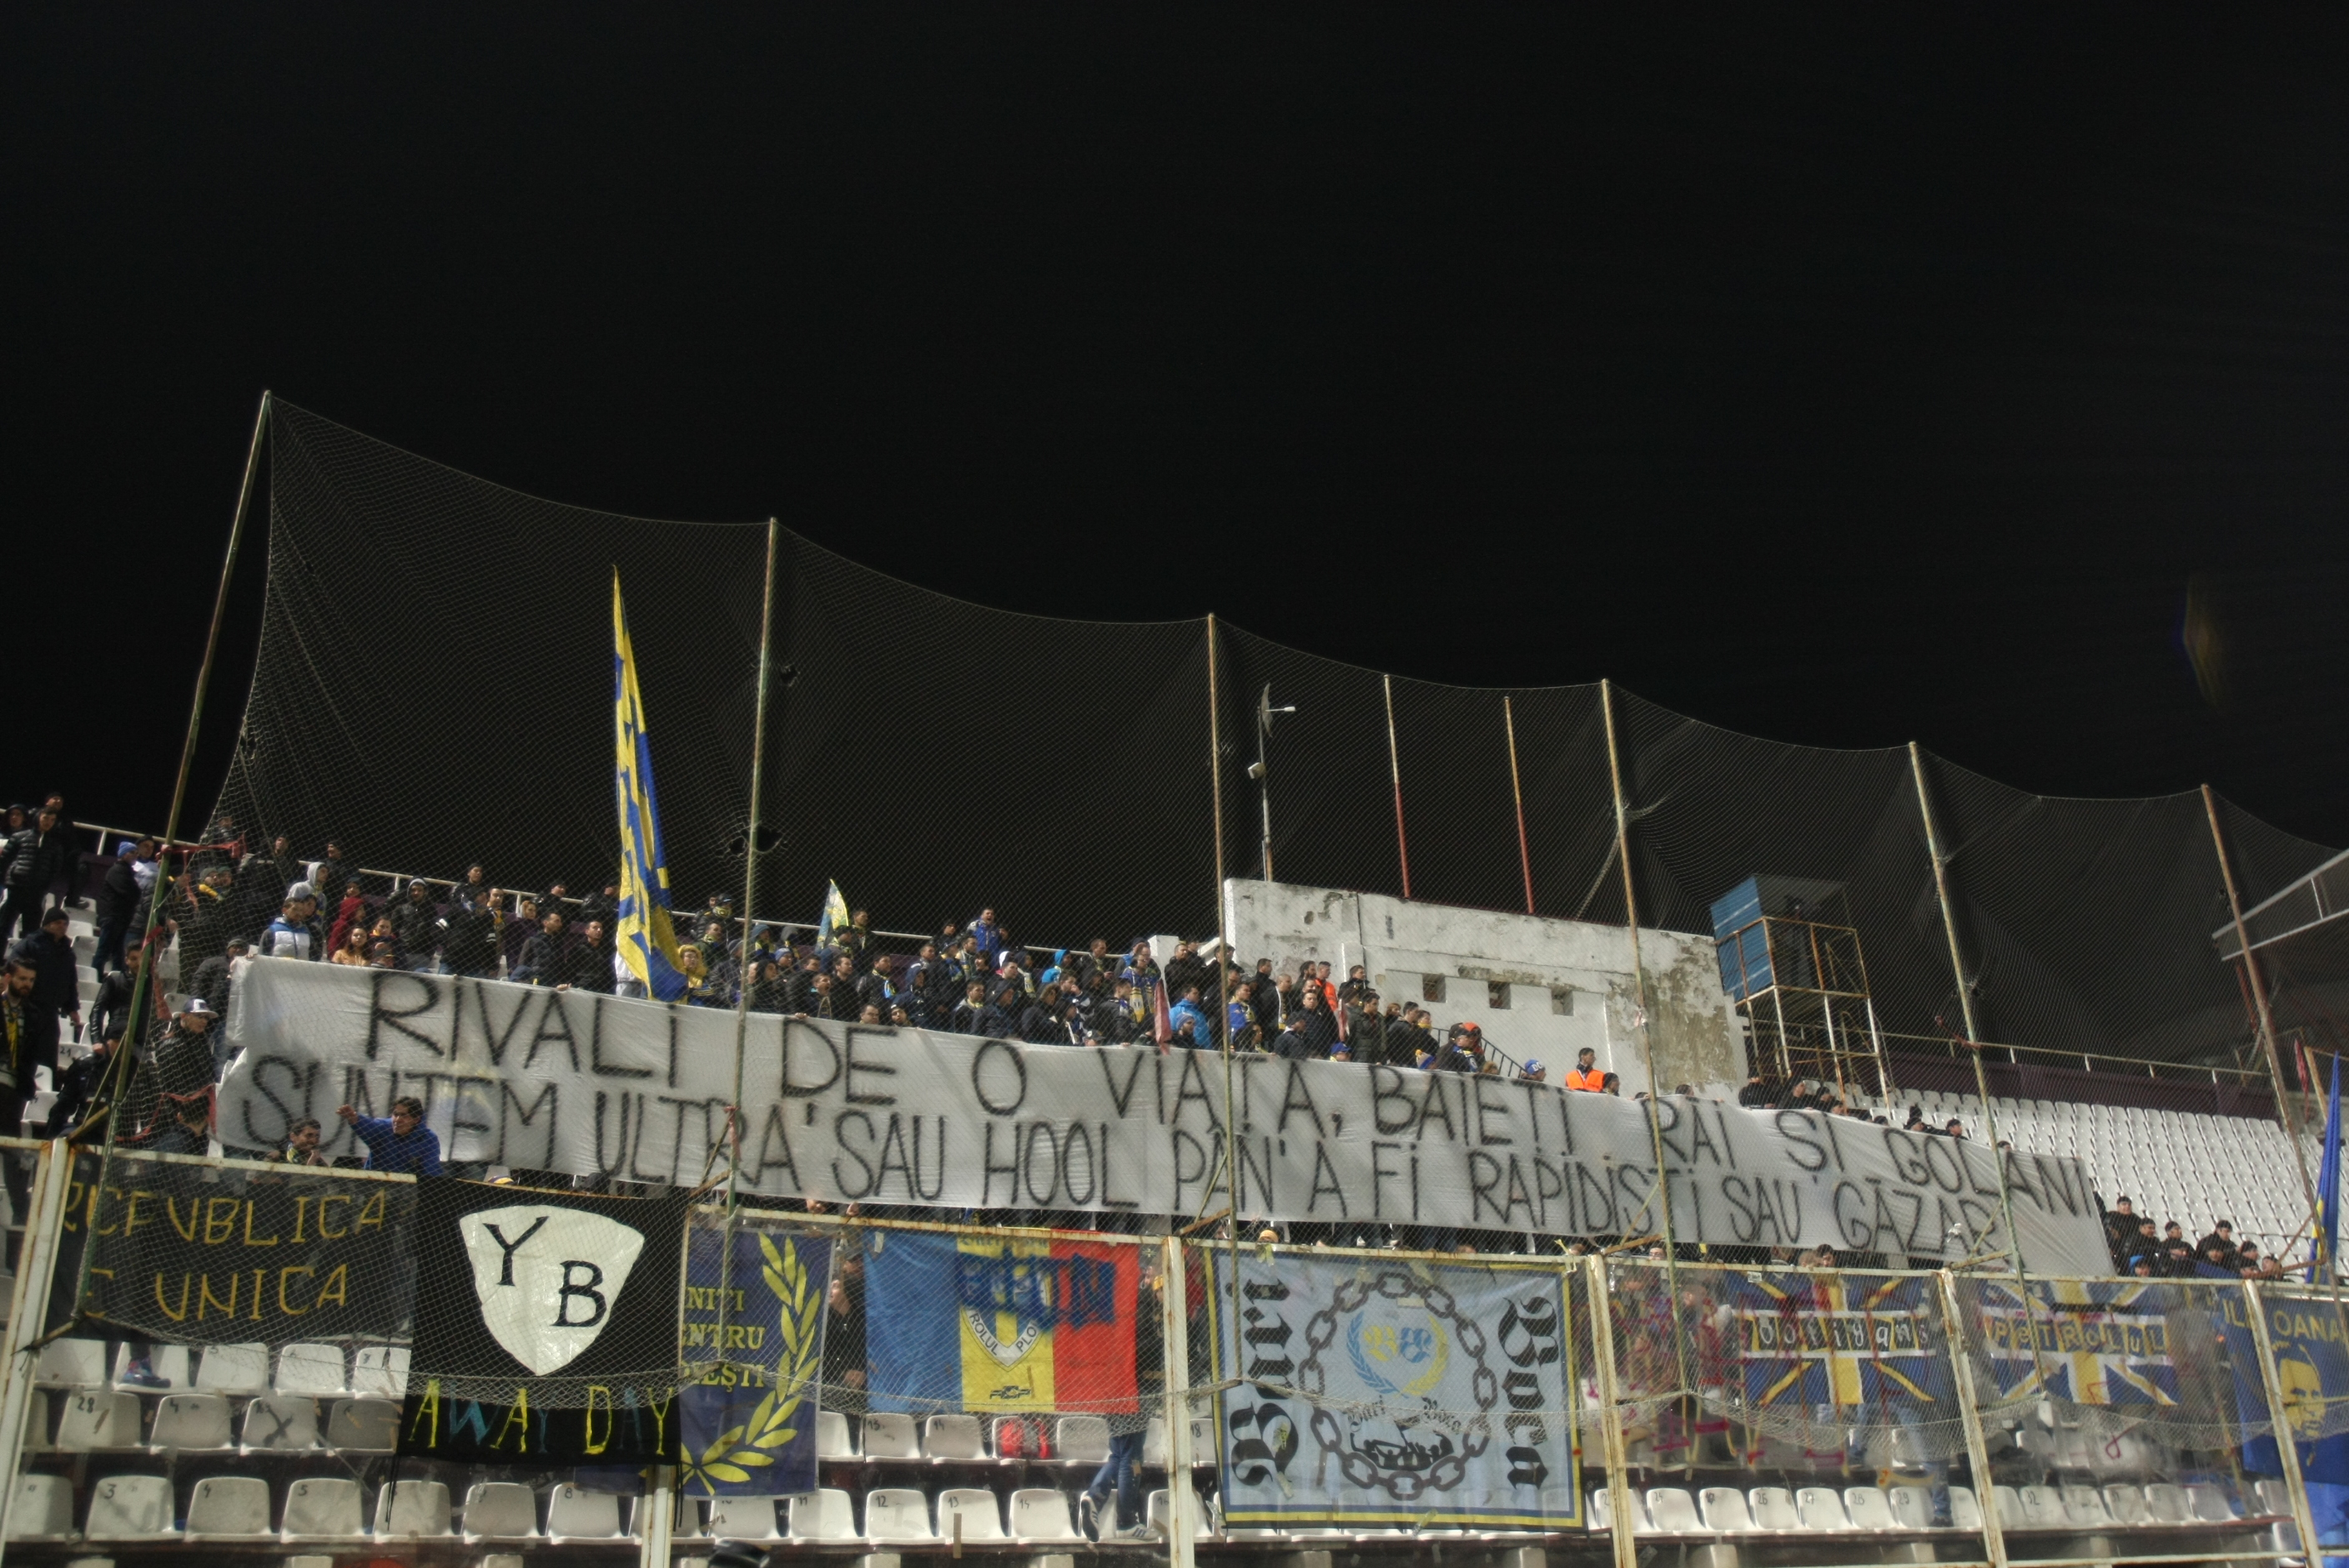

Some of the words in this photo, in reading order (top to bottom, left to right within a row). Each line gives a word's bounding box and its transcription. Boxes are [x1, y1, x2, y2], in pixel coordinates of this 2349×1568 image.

[365, 970, 678, 1088] RIVALI
[779, 1015, 898, 1106] DE
[971, 1039, 1028, 1116] O
[1882, 1128, 2092, 1219] GOLANI
[831, 1108, 947, 1200] SAU
[980, 1120, 1139, 1209] HOOL
[1371, 1140, 1420, 1221] FI
[1722, 1174, 1801, 1244] SAU
[154, 1263, 349, 1322] UNICA
[583, 1385, 674, 1456] DAY
[564, 1487, 574, 1500] 8
[876, 1495, 889, 1509] 12
